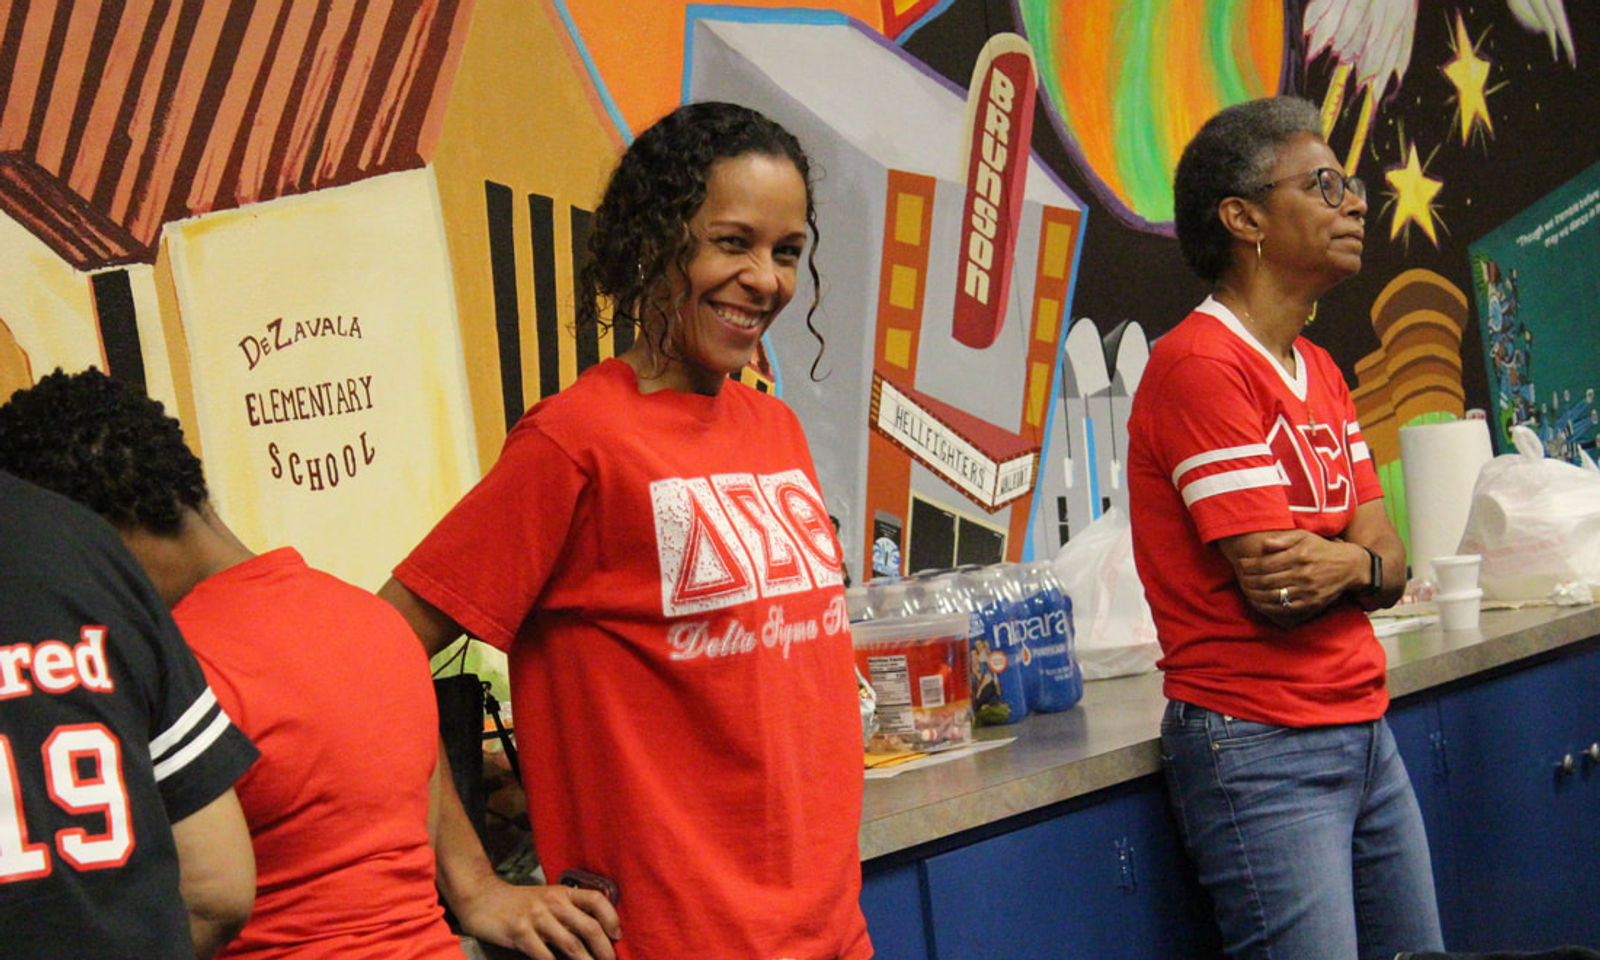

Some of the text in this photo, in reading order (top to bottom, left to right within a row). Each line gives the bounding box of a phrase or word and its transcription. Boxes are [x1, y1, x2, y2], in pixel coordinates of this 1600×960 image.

[964, 68, 1015, 305] BRUNSON
[245, 375, 373, 427] ELEMENTARY
[268, 431, 376, 491] SCHOOL
[895, 404, 986, 490] HELLFIGHTERS
[1265, 412, 1359, 513] ΔΣ
[667, 620, 757, 661] Delta
[763, 604, 818, 660] Sigma
[0, 722, 135, 884] 19
